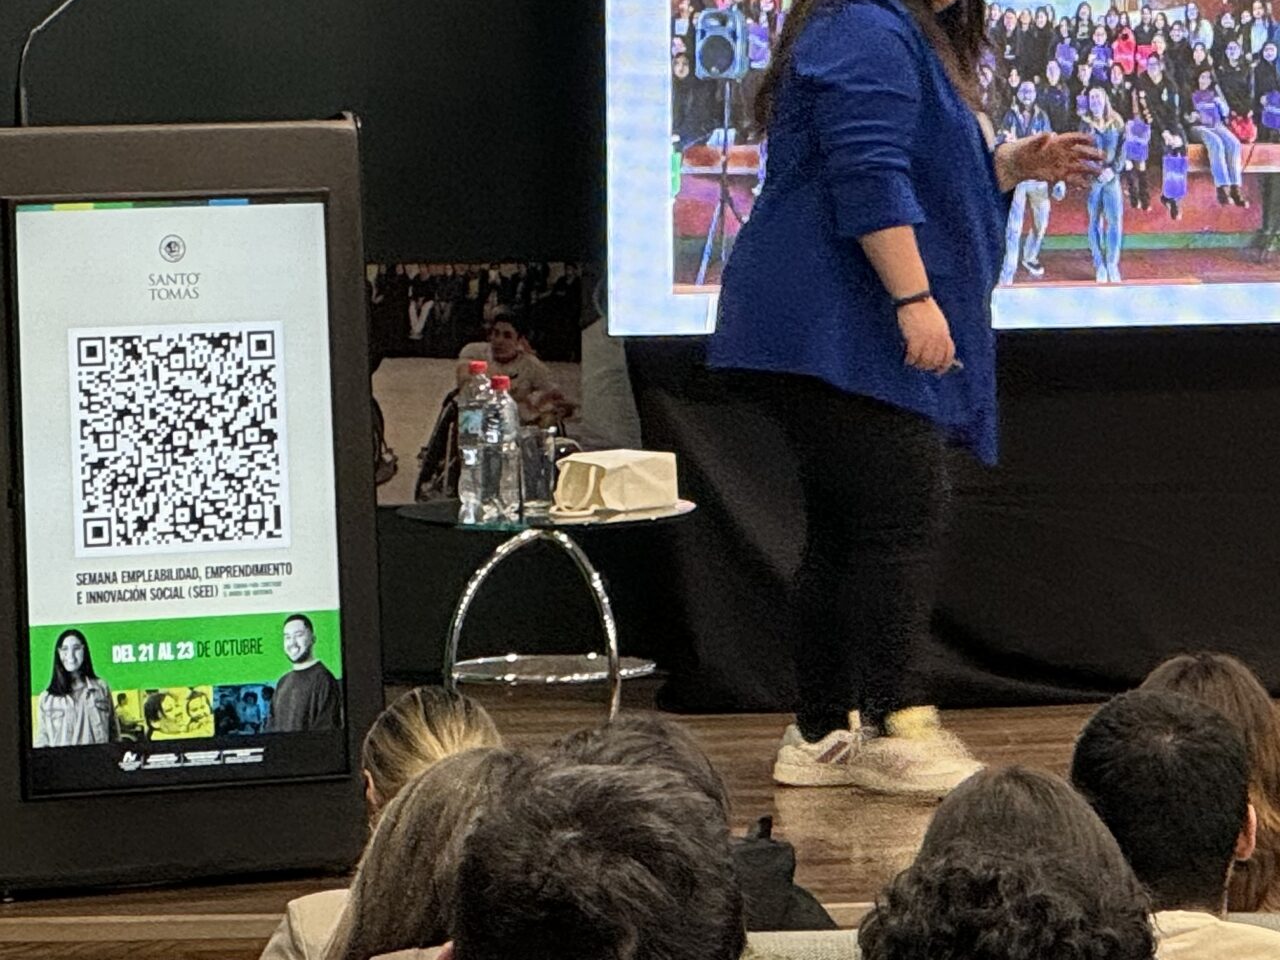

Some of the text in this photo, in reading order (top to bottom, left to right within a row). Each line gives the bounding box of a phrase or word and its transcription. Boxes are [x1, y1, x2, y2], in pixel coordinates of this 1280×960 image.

[148, 272, 200, 287] SANTO
[147, 284, 200, 301] TOMÁS
[76, 562, 293, 586] SEMANA EMPLEABILIDAD, EMPRENDIMIENTO
[77, 591, 83, 605] E
[86, 586, 147, 604] INNOVACIÓN
[149, 586, 185, 600] SOCIAL
[112, 637, 263, 663] DEL 21 AL 23 DE OCTUBRE
